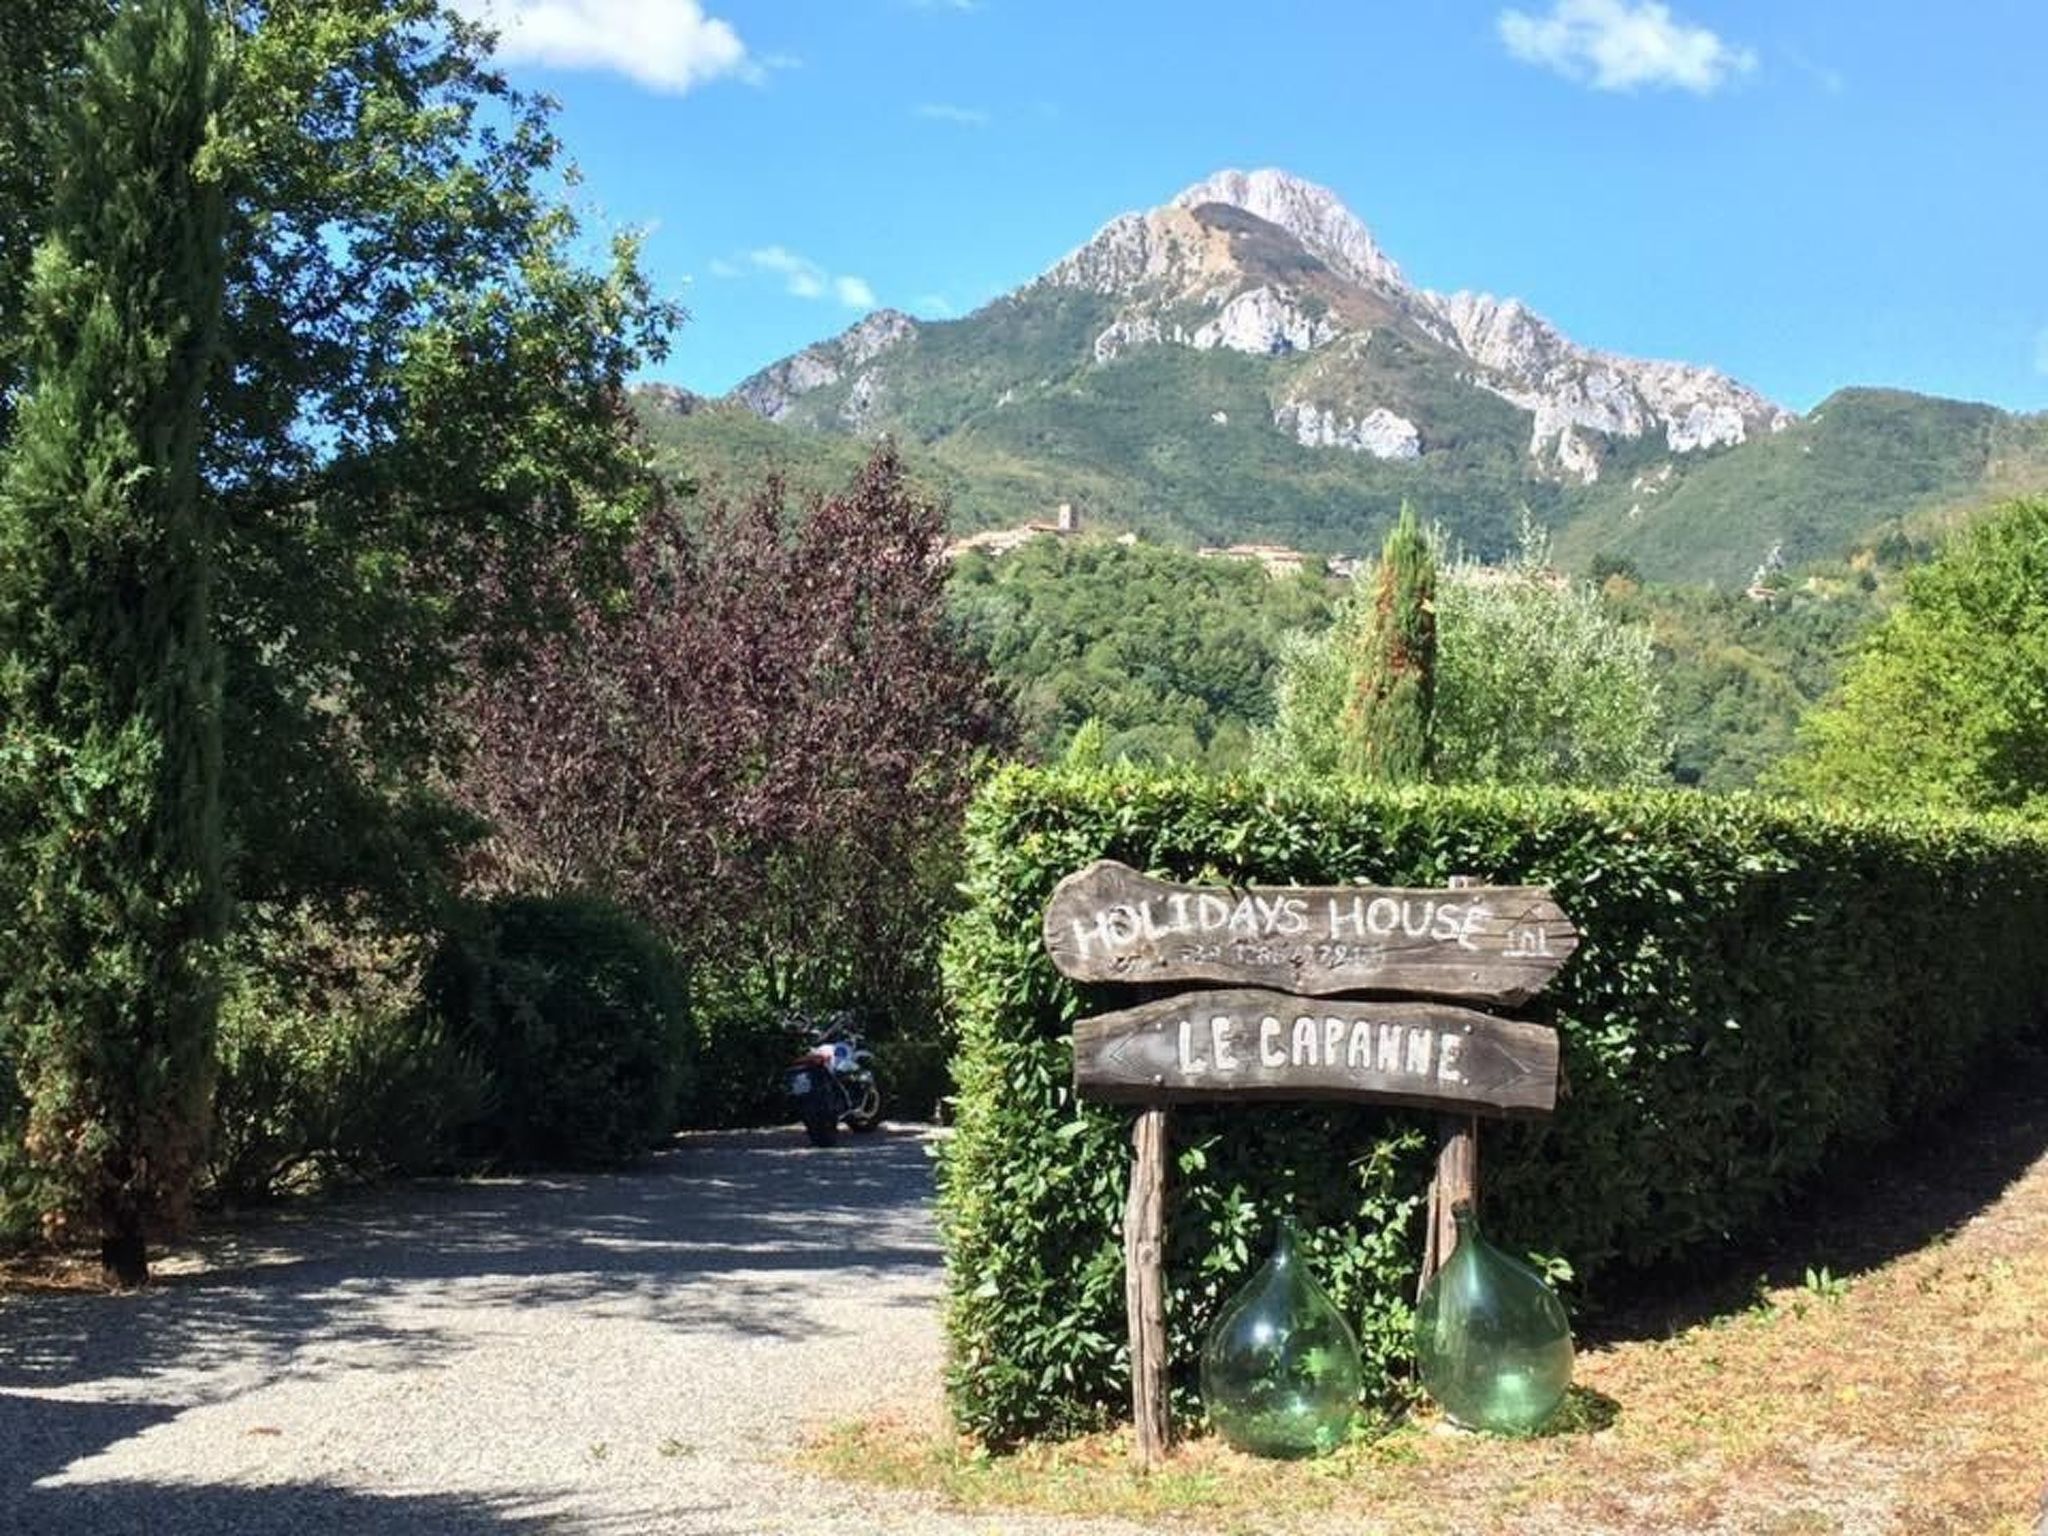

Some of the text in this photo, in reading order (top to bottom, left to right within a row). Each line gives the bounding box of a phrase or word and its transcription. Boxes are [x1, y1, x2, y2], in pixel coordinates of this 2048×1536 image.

[1072, 894, 1310, 959] HOLIDAYS
[1328, 896, 1493, 950] HOUSE
[1178, 1016, 1463, 1081] LE CAPANNE
